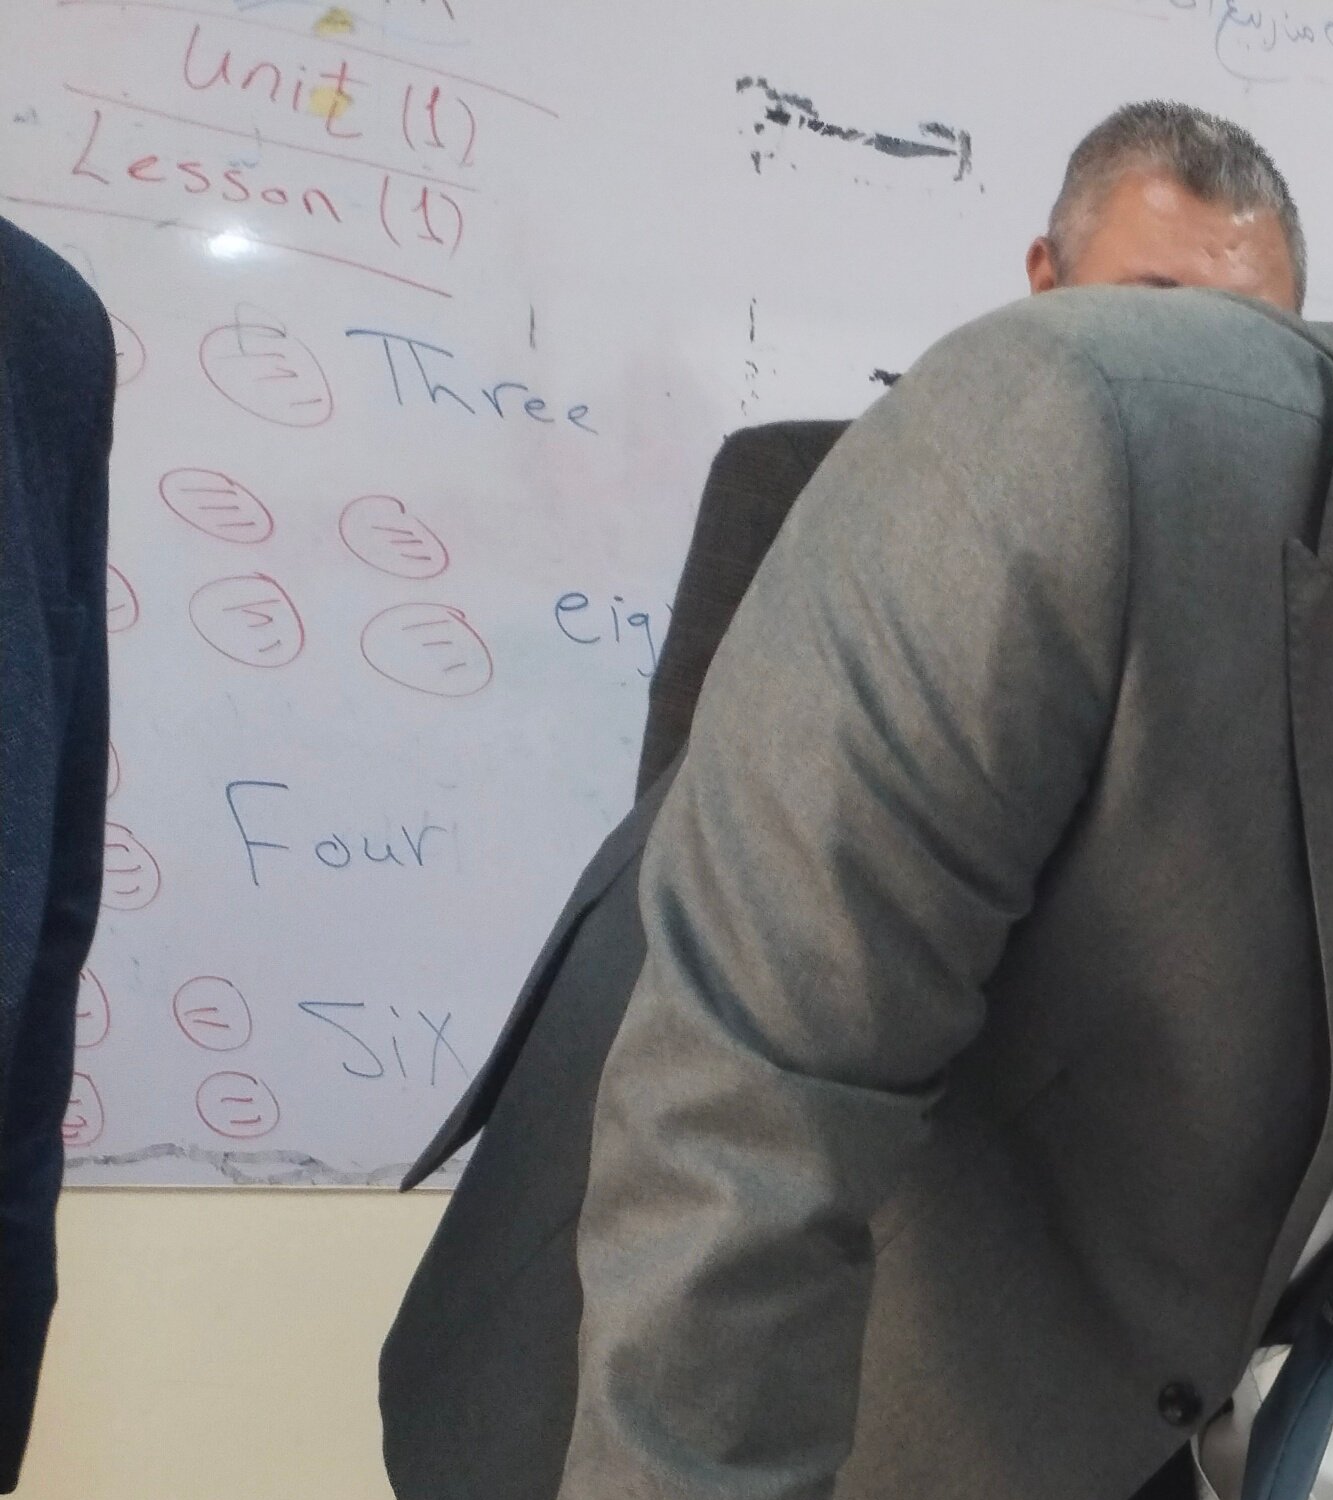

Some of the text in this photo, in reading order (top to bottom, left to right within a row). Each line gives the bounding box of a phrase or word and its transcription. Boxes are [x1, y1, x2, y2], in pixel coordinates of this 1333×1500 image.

[182, 23, 477, 167] Unit (1)
[72, 109, 464, 258] Lesson (1)
[345, 327, 600, 434] Three
[555, 591, 674, 679] eig
[226, 780, 446, 887] Four
[298, 1000, 470, 1087] Six
